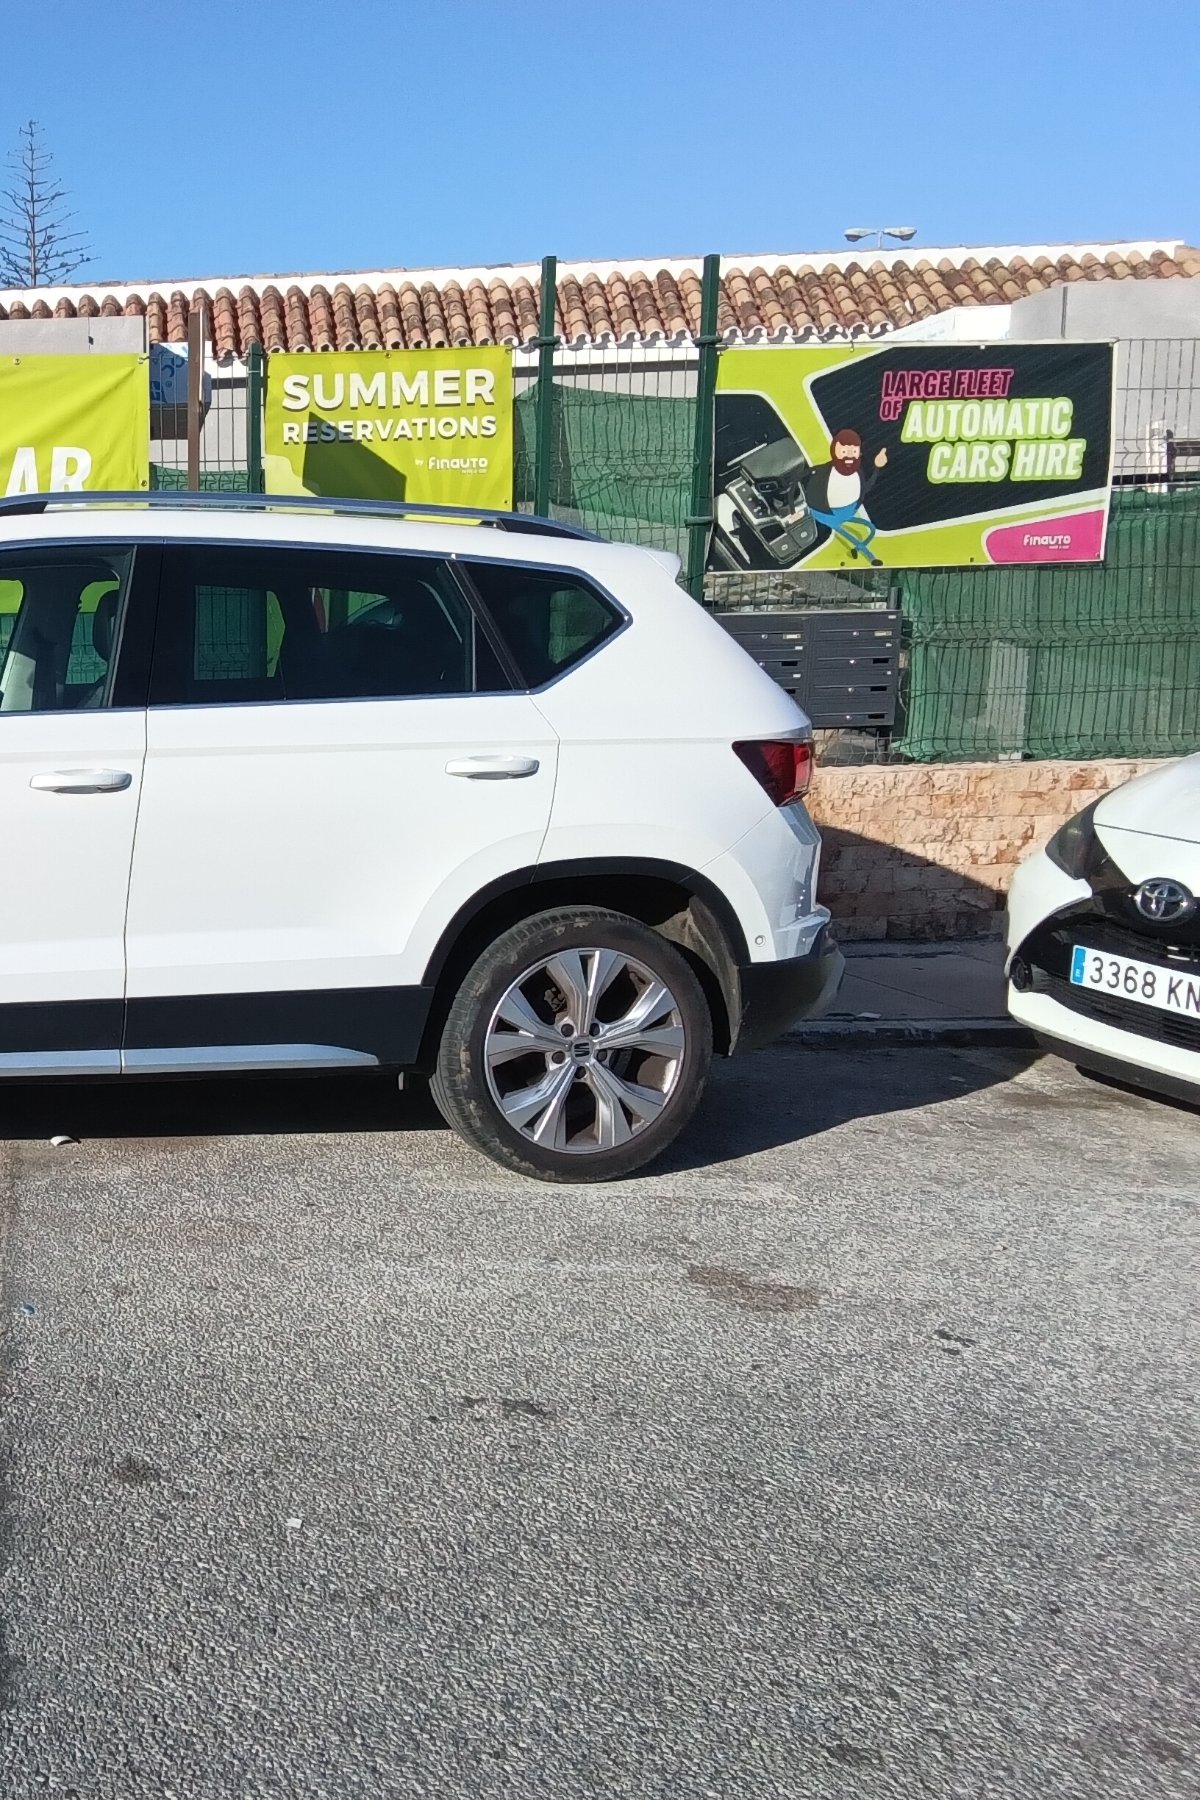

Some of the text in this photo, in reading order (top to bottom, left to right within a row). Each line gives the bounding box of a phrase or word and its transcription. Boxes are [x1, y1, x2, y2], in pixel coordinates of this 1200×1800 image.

[282, 368, 495, 411] SUMMER
[881, 368, 1014, 398] LARGE FLEET
[283, 415, 497, 444] RESERVATIONS
[879, 398, 1072, 441] OF AUTOMATIC
[929, 439, 1086, 482] CARS HIRE
[1089, 956, 1157, 999] 3368
